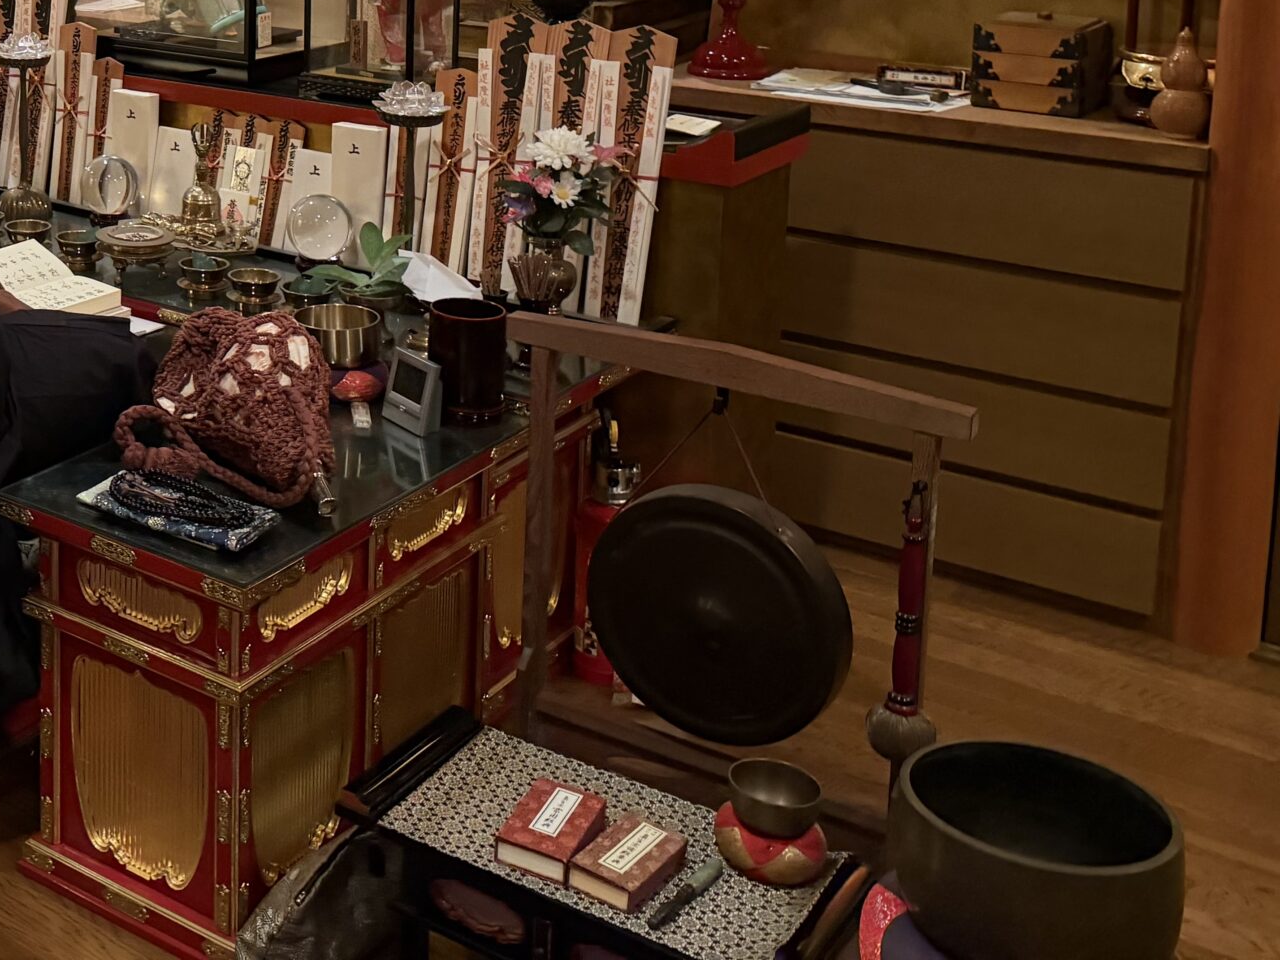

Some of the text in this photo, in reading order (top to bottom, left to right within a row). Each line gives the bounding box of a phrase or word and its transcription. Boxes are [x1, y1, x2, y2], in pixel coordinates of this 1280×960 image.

[126, 108, 136, 119] 上
[170, 141, 181, 152] 上
[348, 143, 361, 155] 上
[309, 165, 321, 176] 上
